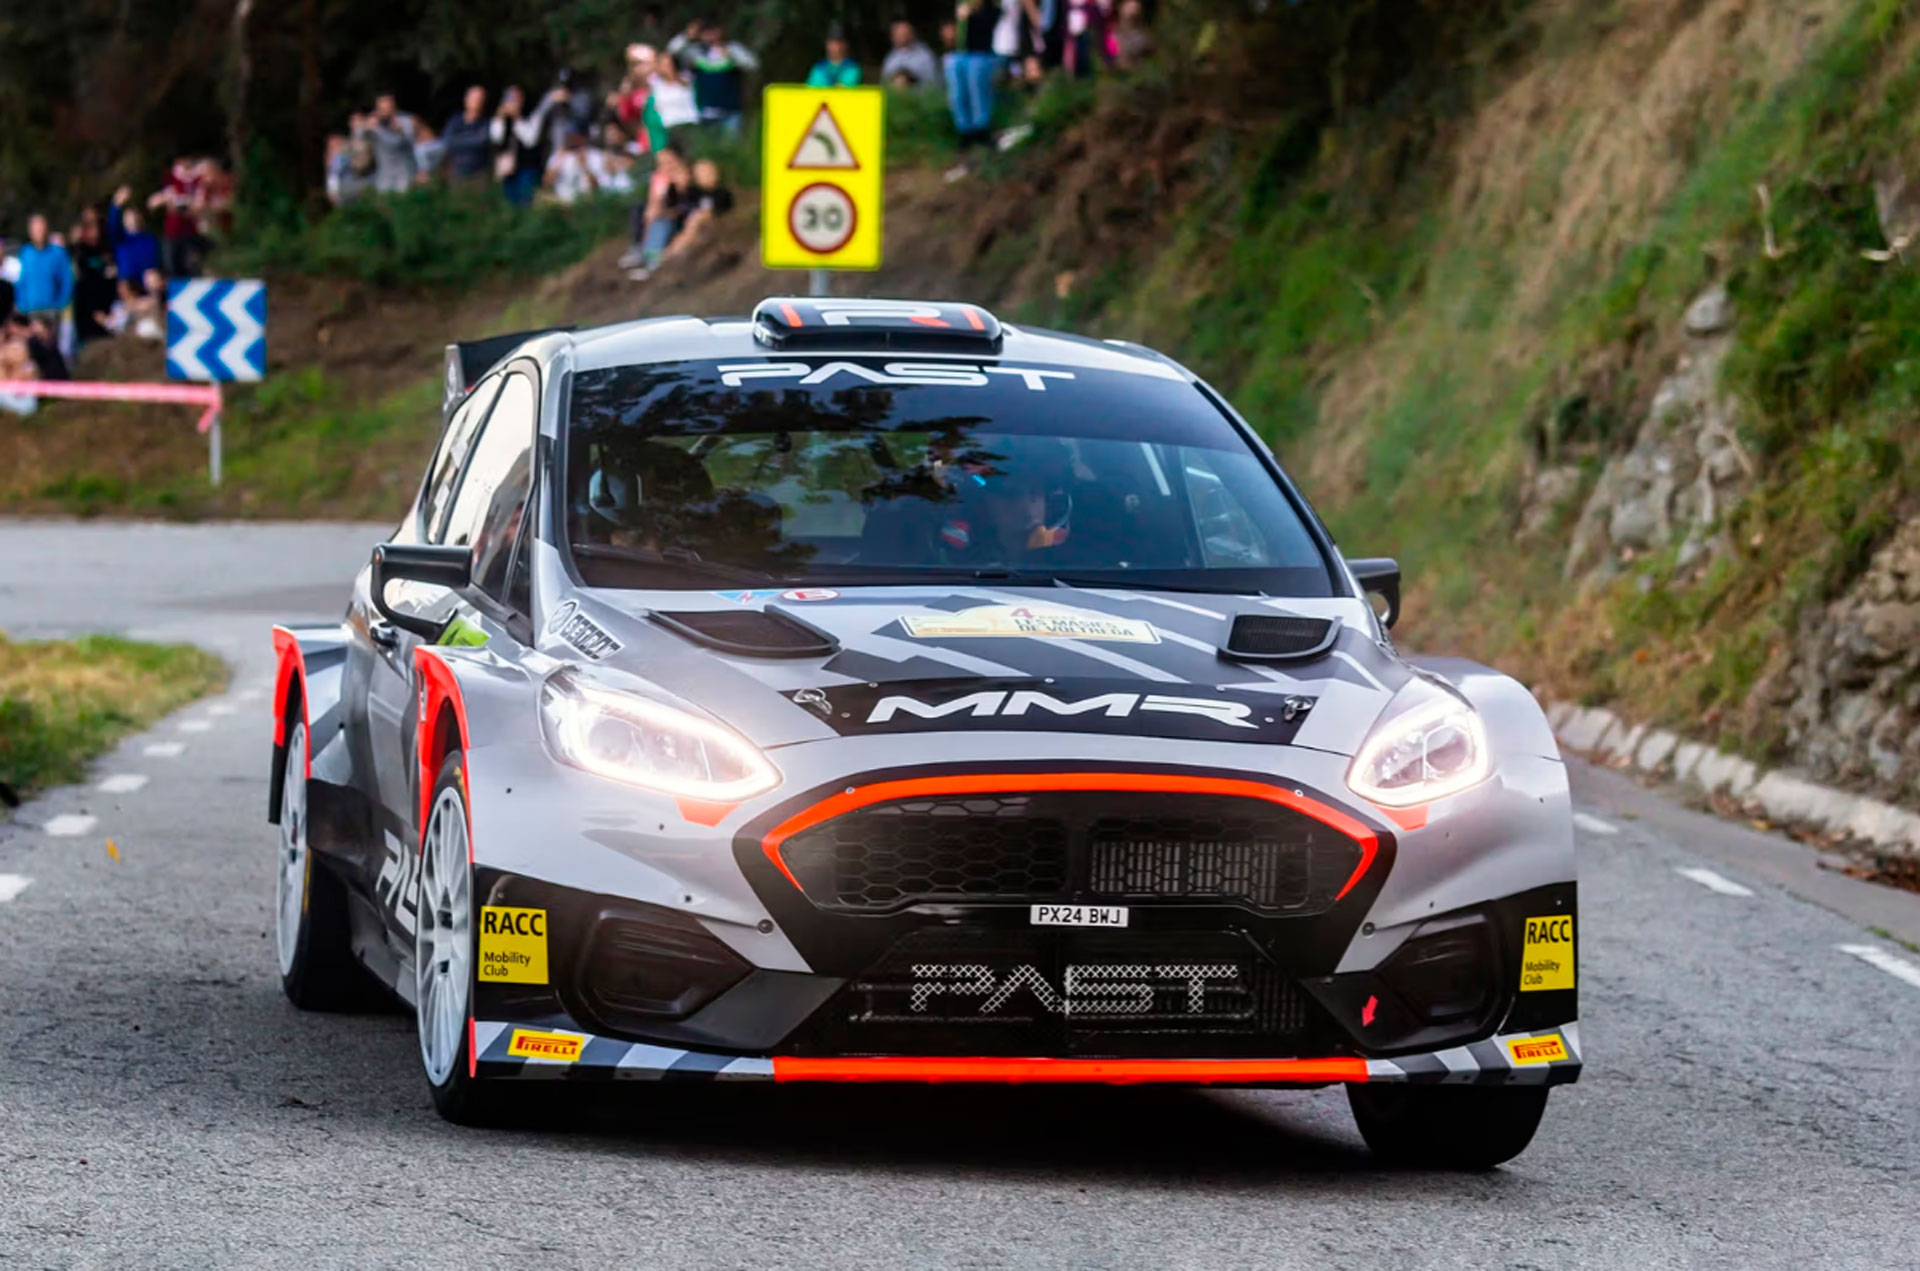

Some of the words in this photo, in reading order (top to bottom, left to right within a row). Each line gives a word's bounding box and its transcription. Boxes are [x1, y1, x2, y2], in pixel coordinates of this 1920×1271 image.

[801, 207, 845, 231] 30
[716, 361, 1075, 391] PAST
[866, 690, 1260, 729] MMR
[483, 911, 544, 937] RACC
[1038, 906, 1082, 923] PX24
[1088, 908, 1121, 925] BWJ
[1526, 919, 1571, 945] RACC
[483, 951, 531, 968] Mobility
[1525, 959, 1561, 974] Mobility
[483, 964, 509, 977] Club
[1523, 973, 1544, 985] Club
[910, 964, 1239, 1013] PAST
[515, 1035, 578, 1055] PIRELLI
[1512, 1040, 1562, 1060] PIRELLI
